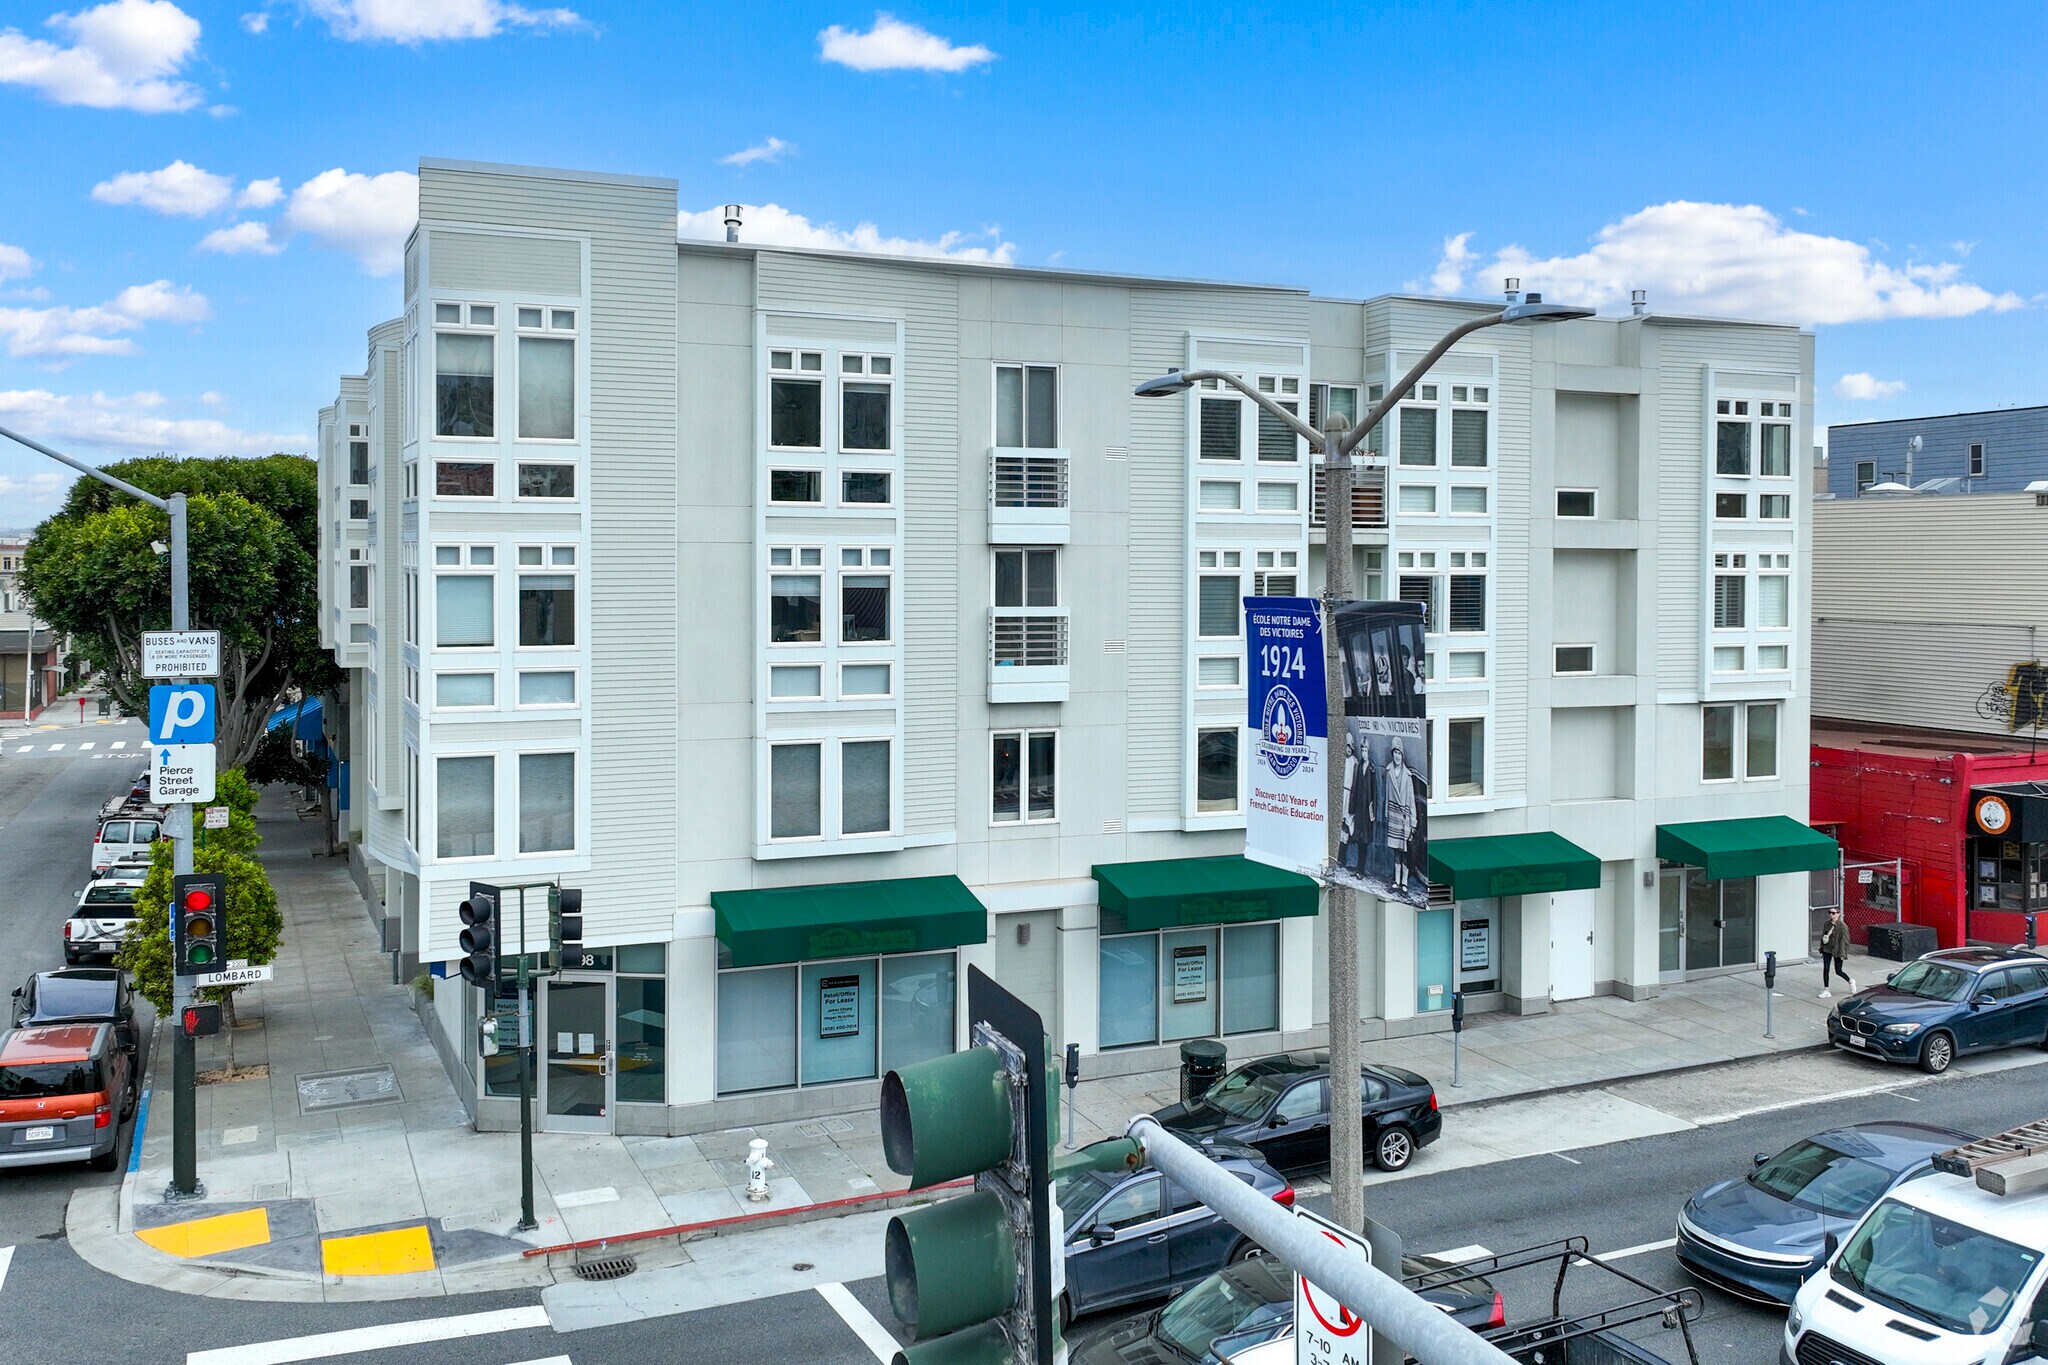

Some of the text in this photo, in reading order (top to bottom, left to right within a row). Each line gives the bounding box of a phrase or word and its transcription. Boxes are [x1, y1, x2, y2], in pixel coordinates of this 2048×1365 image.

[1253, 613, 1311, 626] ÉCOLE NOTRE DAME
[1260, 627, 1304, 638] DES VICTOIRES
[145, 637, 175, 646] BUSES
[188, 636, 216, 645] VANS
[155, 663, 207, 671] PROHIBITED
[1261, 645, 1306, 679] 1924
[160, 766, 193, 775] Pierce
[159, 776, 193, 785] Street
[159, 786, 199, 796] Garage
[1255, 788, 1276, 800] Discover
[1289, 795, 1308, 806] Years
[1310, 799, 1318, 808] of
[1250, 799, 1324, 821] French Catholic Education
[208, 970, 262, 982] LOMBARD
[752, 1171, 760, 1179] 12
[1306, 1330, 1360, 1365] 7-10 AM
